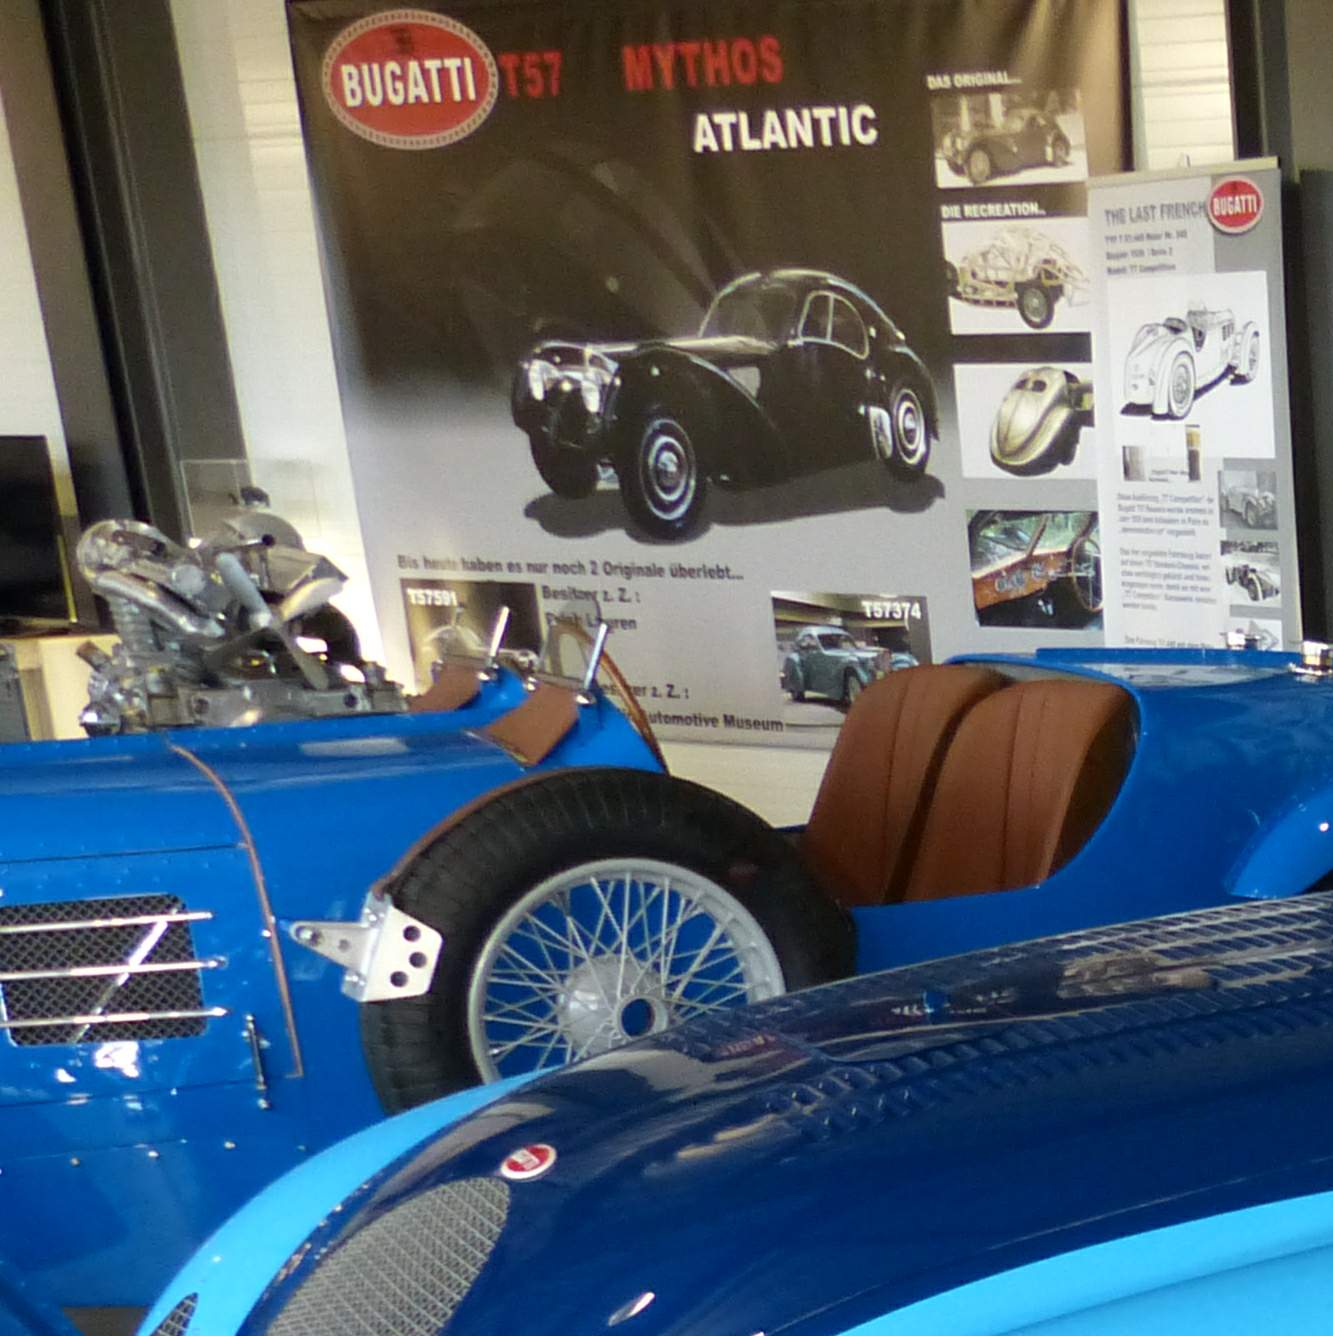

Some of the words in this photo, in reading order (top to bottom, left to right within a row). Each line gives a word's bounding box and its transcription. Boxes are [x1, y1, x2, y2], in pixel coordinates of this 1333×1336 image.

[499, 52, 562, 98] T57
[621, 36, 784, 91] MYTHOS
[340, 57, 476, 107] BUGATTI
[694, 103, 879, 153] ATLANTIC
[940, 205, 961, 219] DIE
[1105, 208, 1126, 226] THE
[1129, 204, 1157, 224] LAST
[1160, 200, 1205, 221] FRENCH
[1213, 194, 1258, 216] BUGATTI
[398, 555, 418, 570] Bis
[462, 557, 503, 572] haben
[507, 562, 522, 573] es
[553, 562, 585, 575] noch
[590, 561, 598, 575] 2
[603, 561, 665, 580] Originale
[861, 601, 921, 620] T57374
[648, 711, 718, 728] utomotive
[723, 713, 784, 732] Museum
